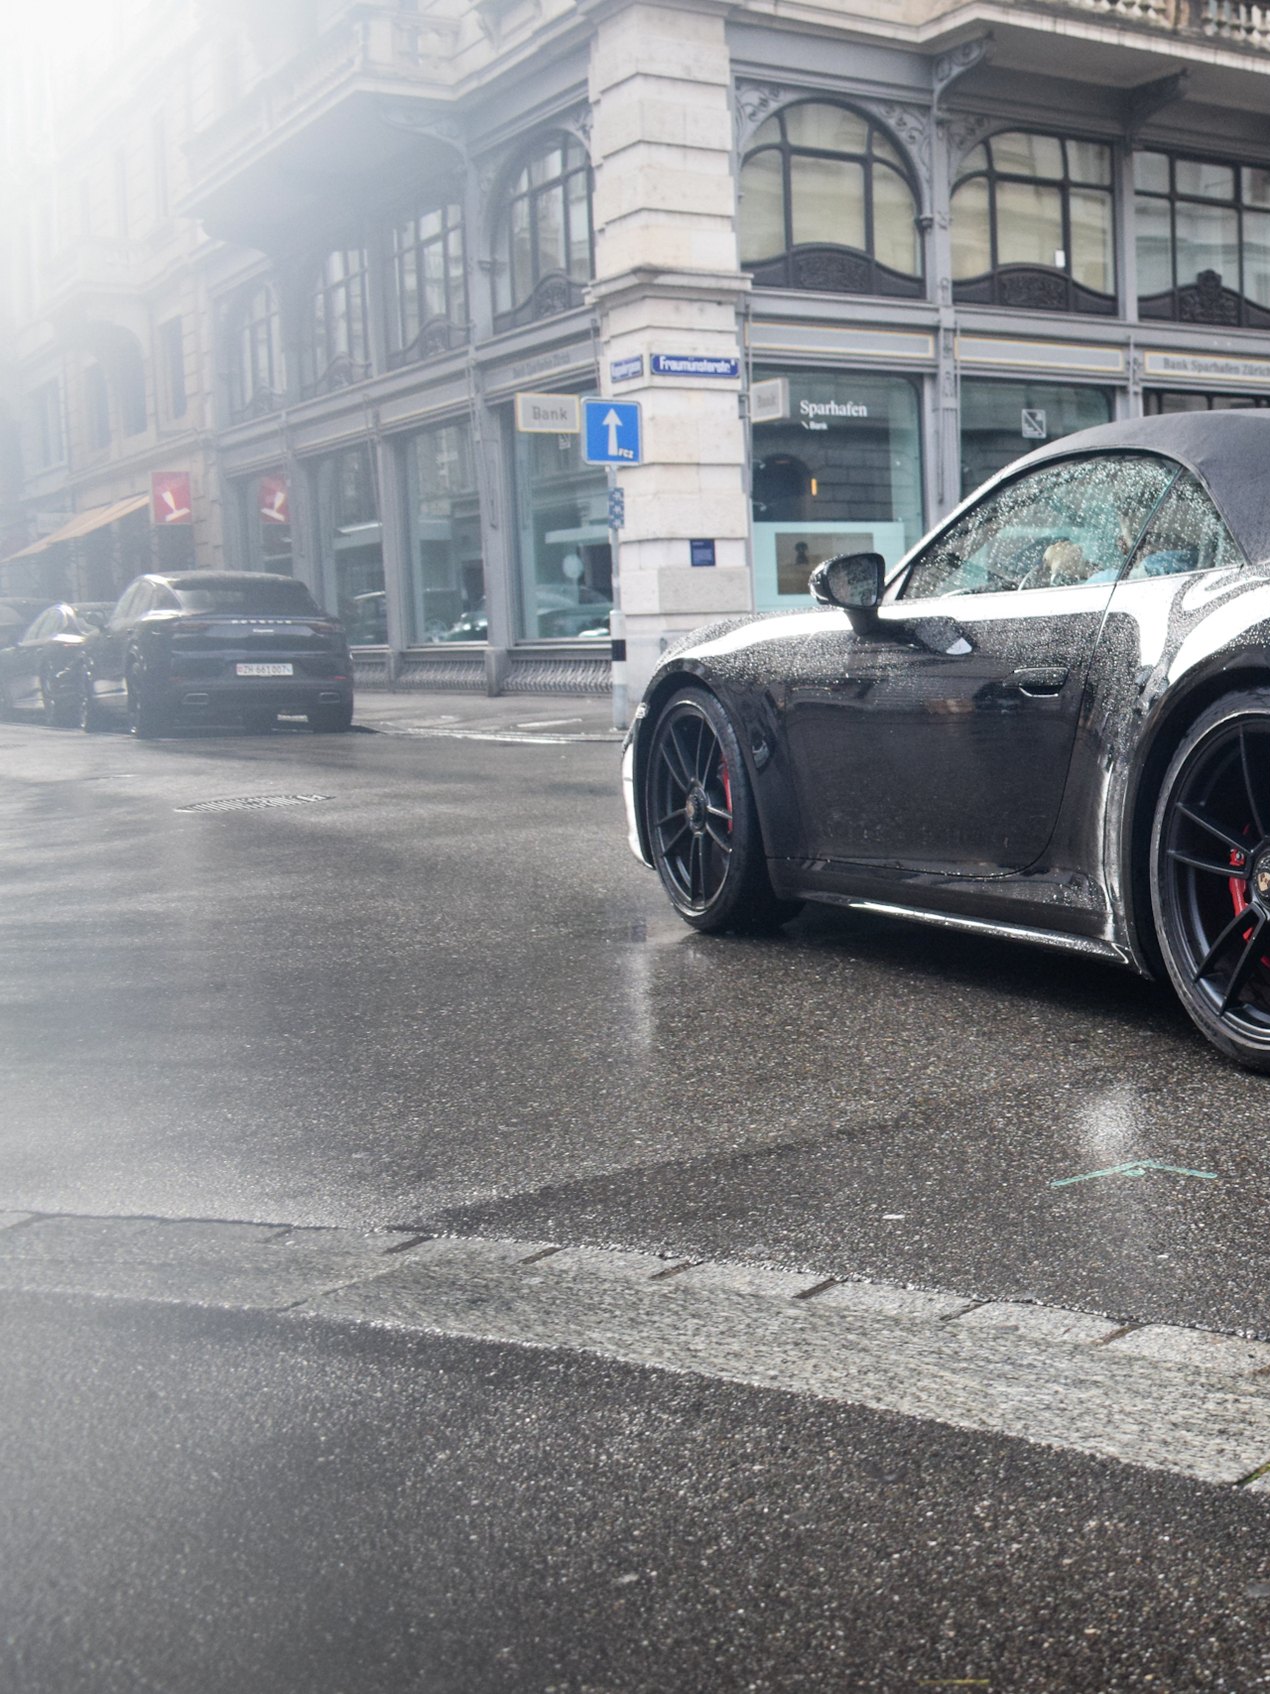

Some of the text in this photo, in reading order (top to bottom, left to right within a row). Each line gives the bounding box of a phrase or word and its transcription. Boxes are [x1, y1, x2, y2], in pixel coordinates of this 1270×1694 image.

[1163, 357, 1188, 371] Bank
[1191, 359, 1240, 374] Sparhafen
[531, 405, 568, 421] Bank
[800, 400, 868, 418] Sparhafen
